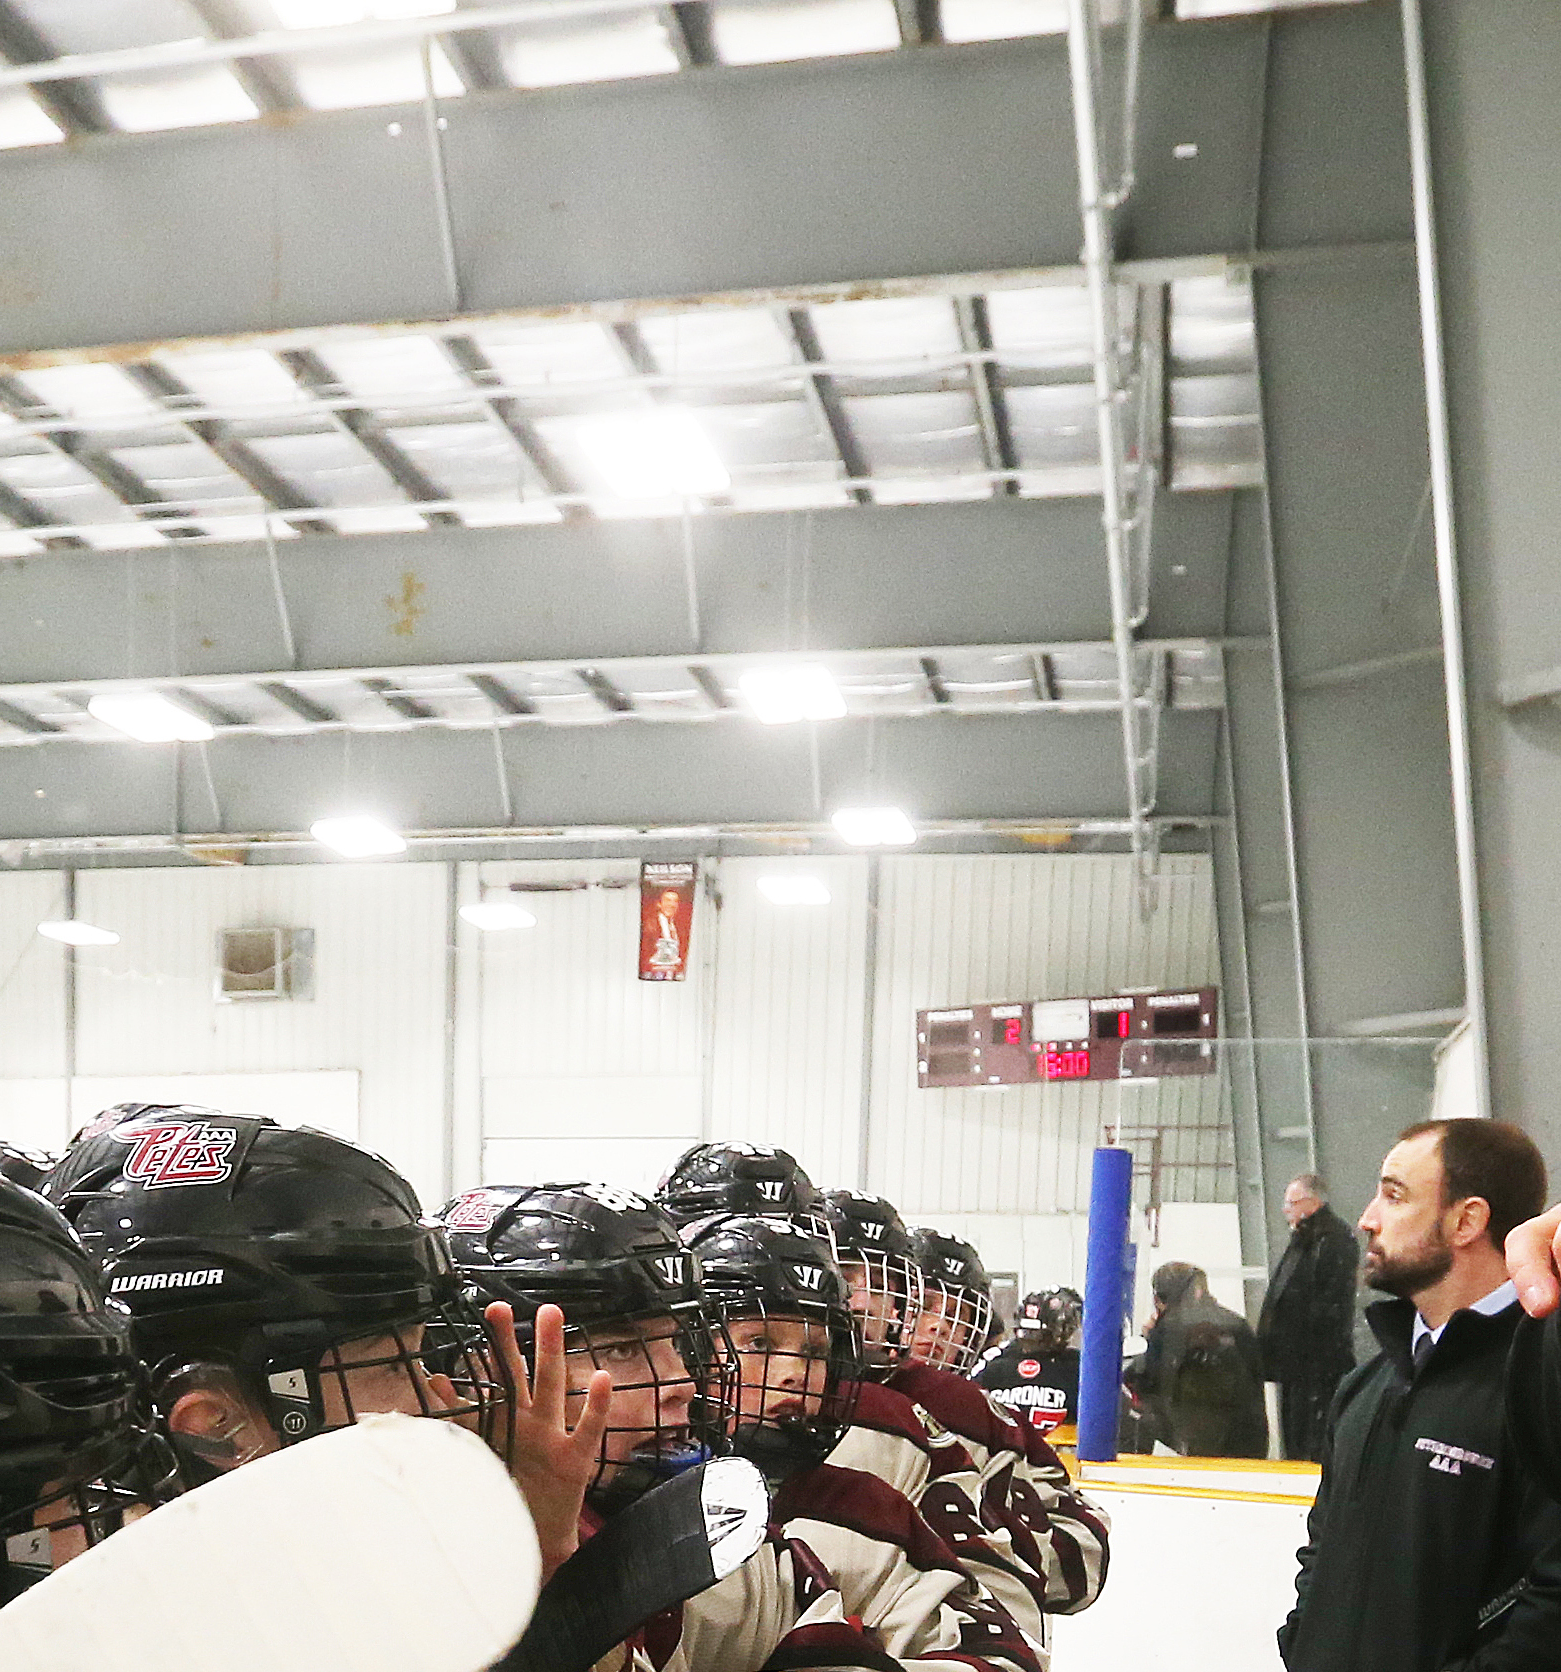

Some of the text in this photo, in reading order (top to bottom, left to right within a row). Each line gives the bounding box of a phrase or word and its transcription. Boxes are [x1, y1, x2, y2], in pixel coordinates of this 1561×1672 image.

[1005, 1018, 1021, 1045] 2
[1118, 1012, 1129, 1038] 1
[199, 1130, 233, 1142] AAA
[111, 1268, 224, 1293] WARRIOR
[990, 1385, 1067, 1409] GARDNER
